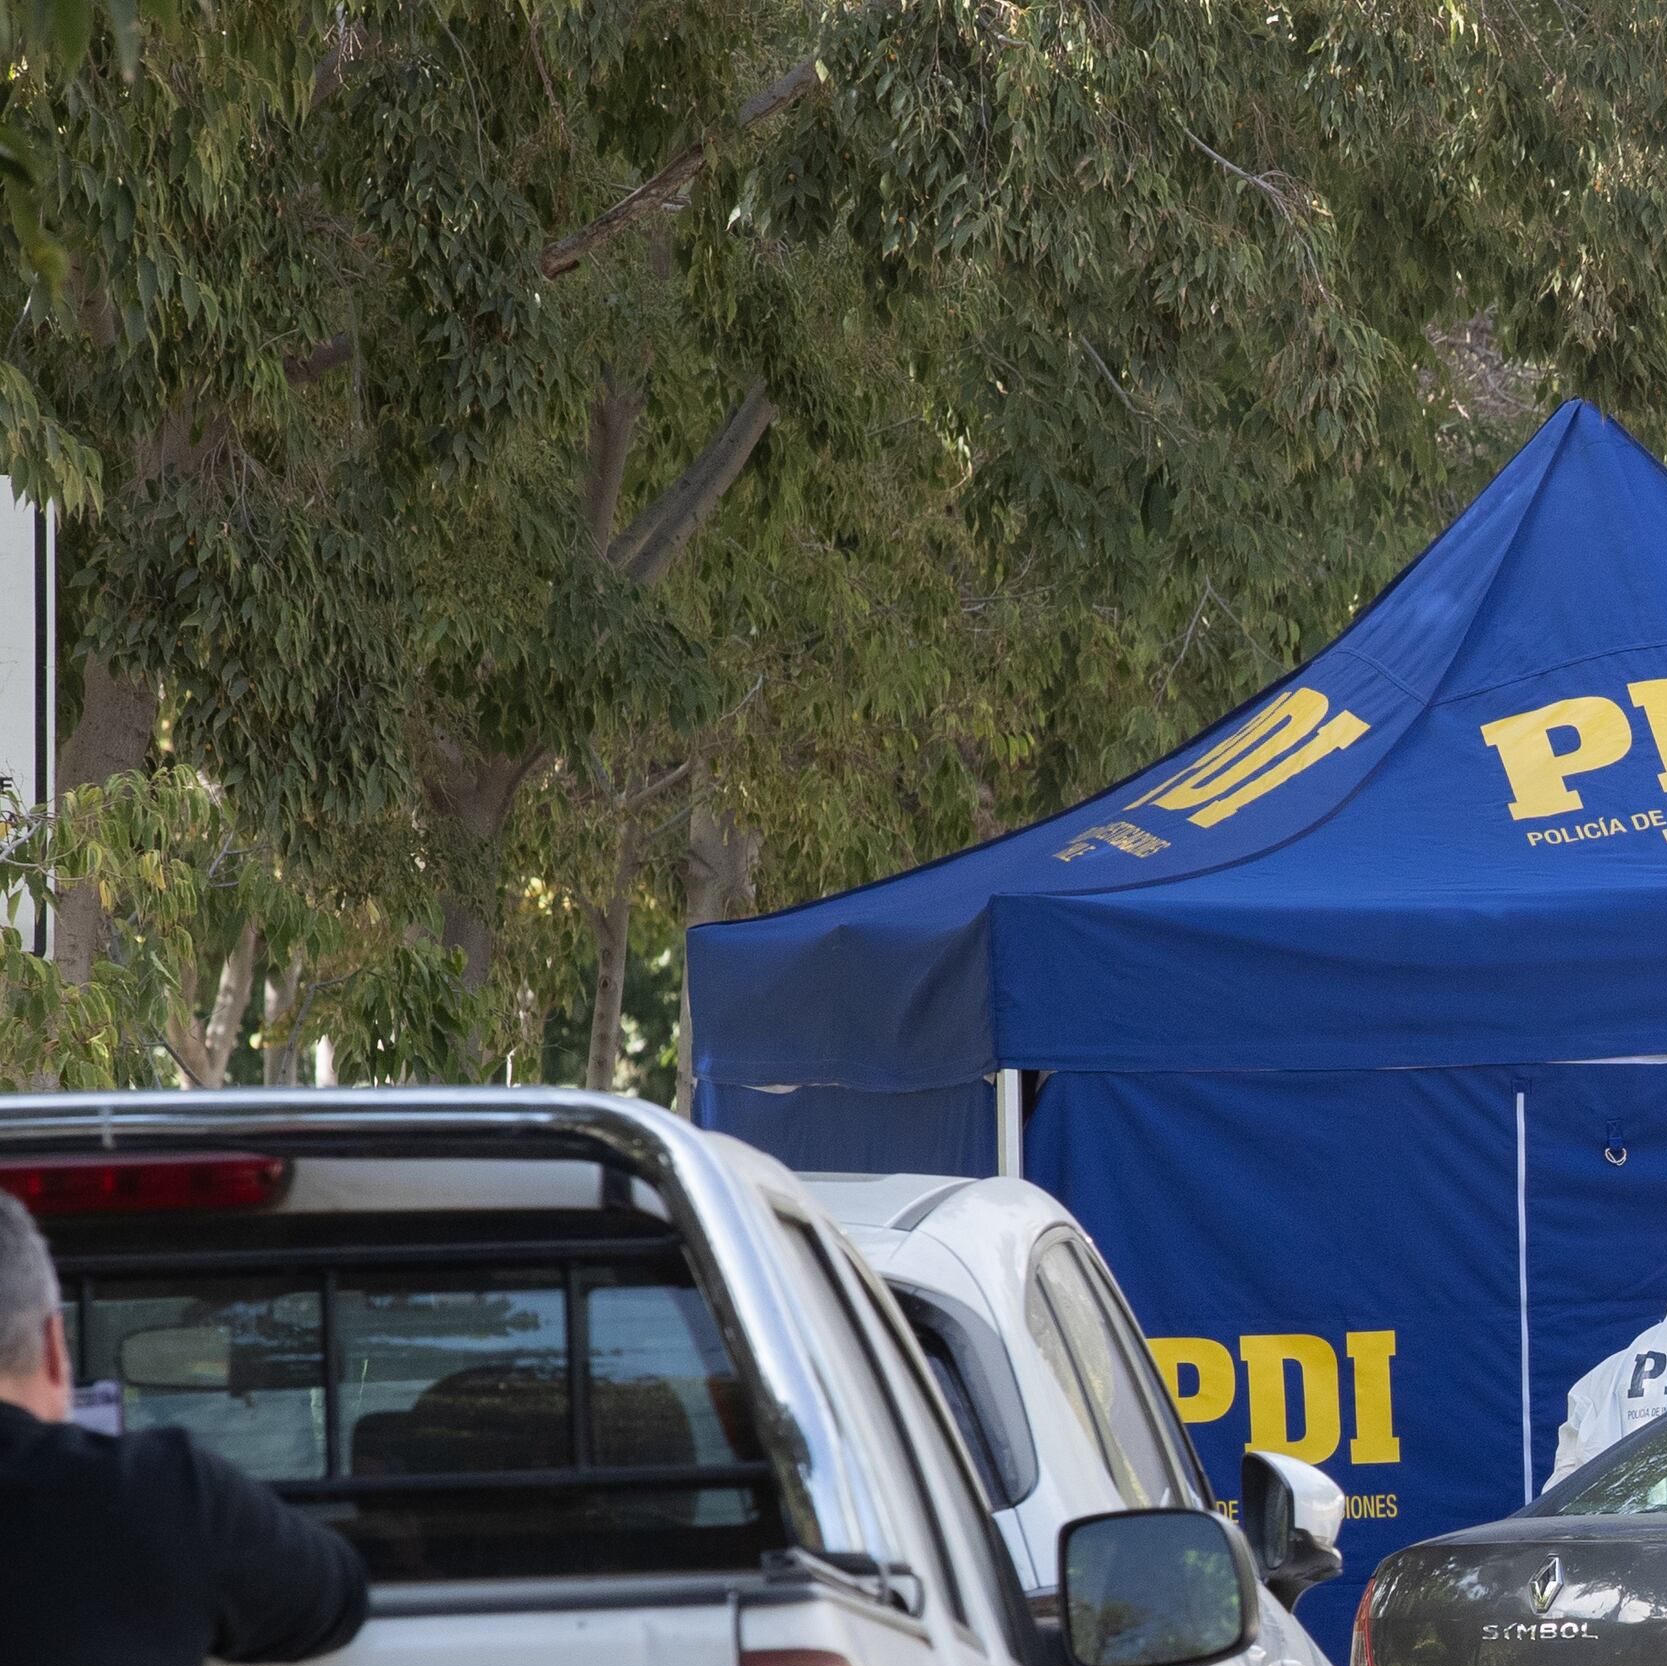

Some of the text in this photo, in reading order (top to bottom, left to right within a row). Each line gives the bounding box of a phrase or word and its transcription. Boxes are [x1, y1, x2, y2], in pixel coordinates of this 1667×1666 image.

[1526, 816, 1627, 847] POLICÍA
[1631, 809, 1667, 832] DE
[1145, 1330, 1400, 1465] PDI
[1481, 1622, 1599, 1640] SYMBOL
